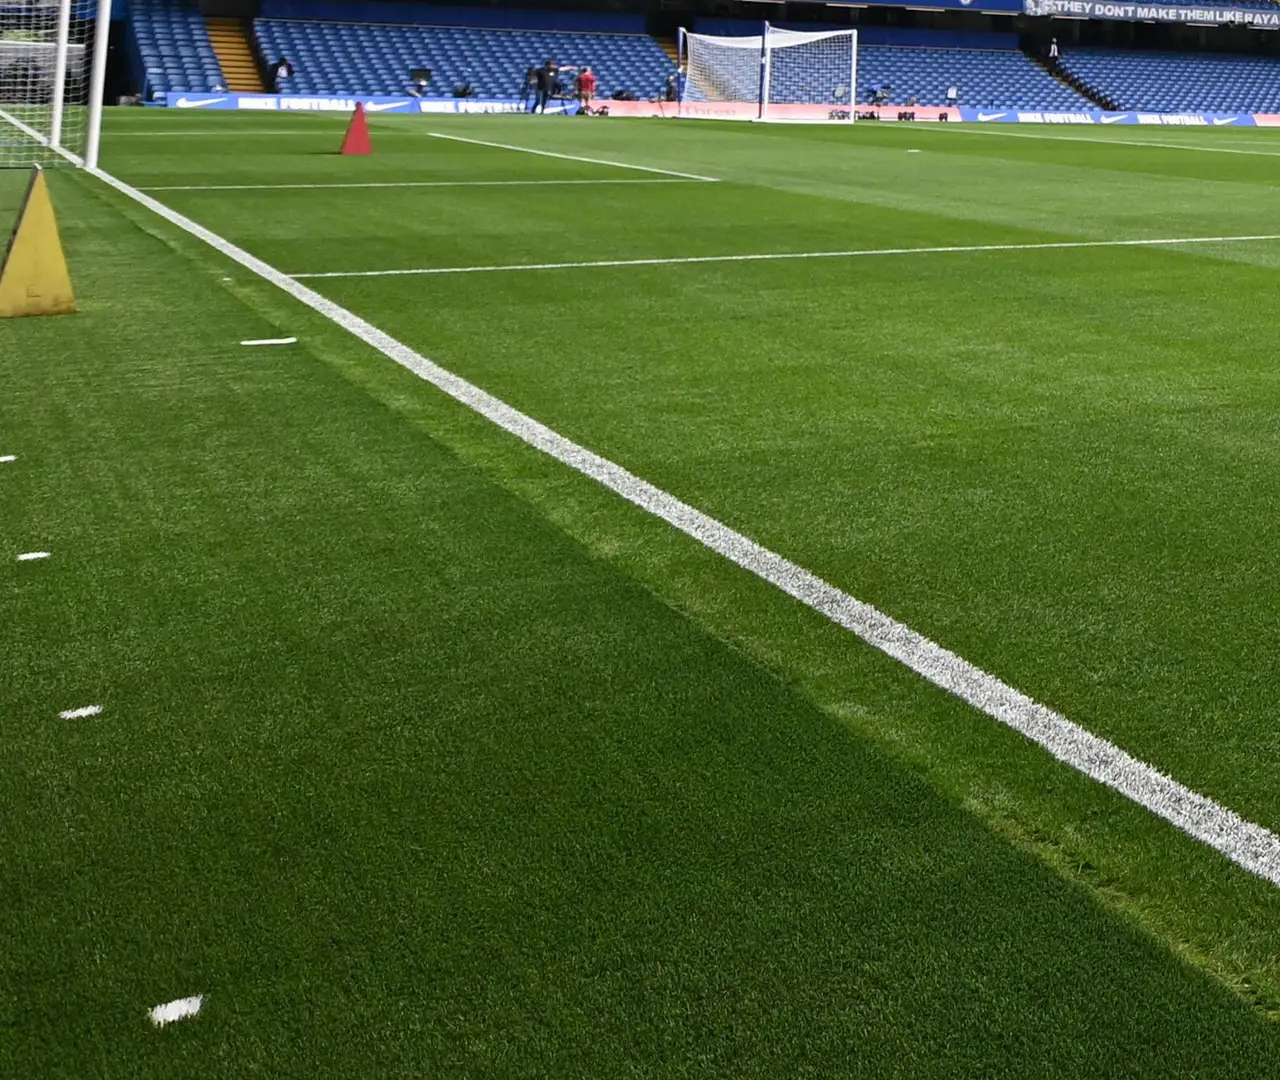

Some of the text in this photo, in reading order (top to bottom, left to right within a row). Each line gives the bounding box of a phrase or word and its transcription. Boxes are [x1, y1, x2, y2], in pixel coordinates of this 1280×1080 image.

[1056, 0, 1092, 13] THEY
[1136, 7, 1177, 20] MAKE
[1178, 9, 1215, 21] THEM
[1215, 11, 1243, 23] LIKE
